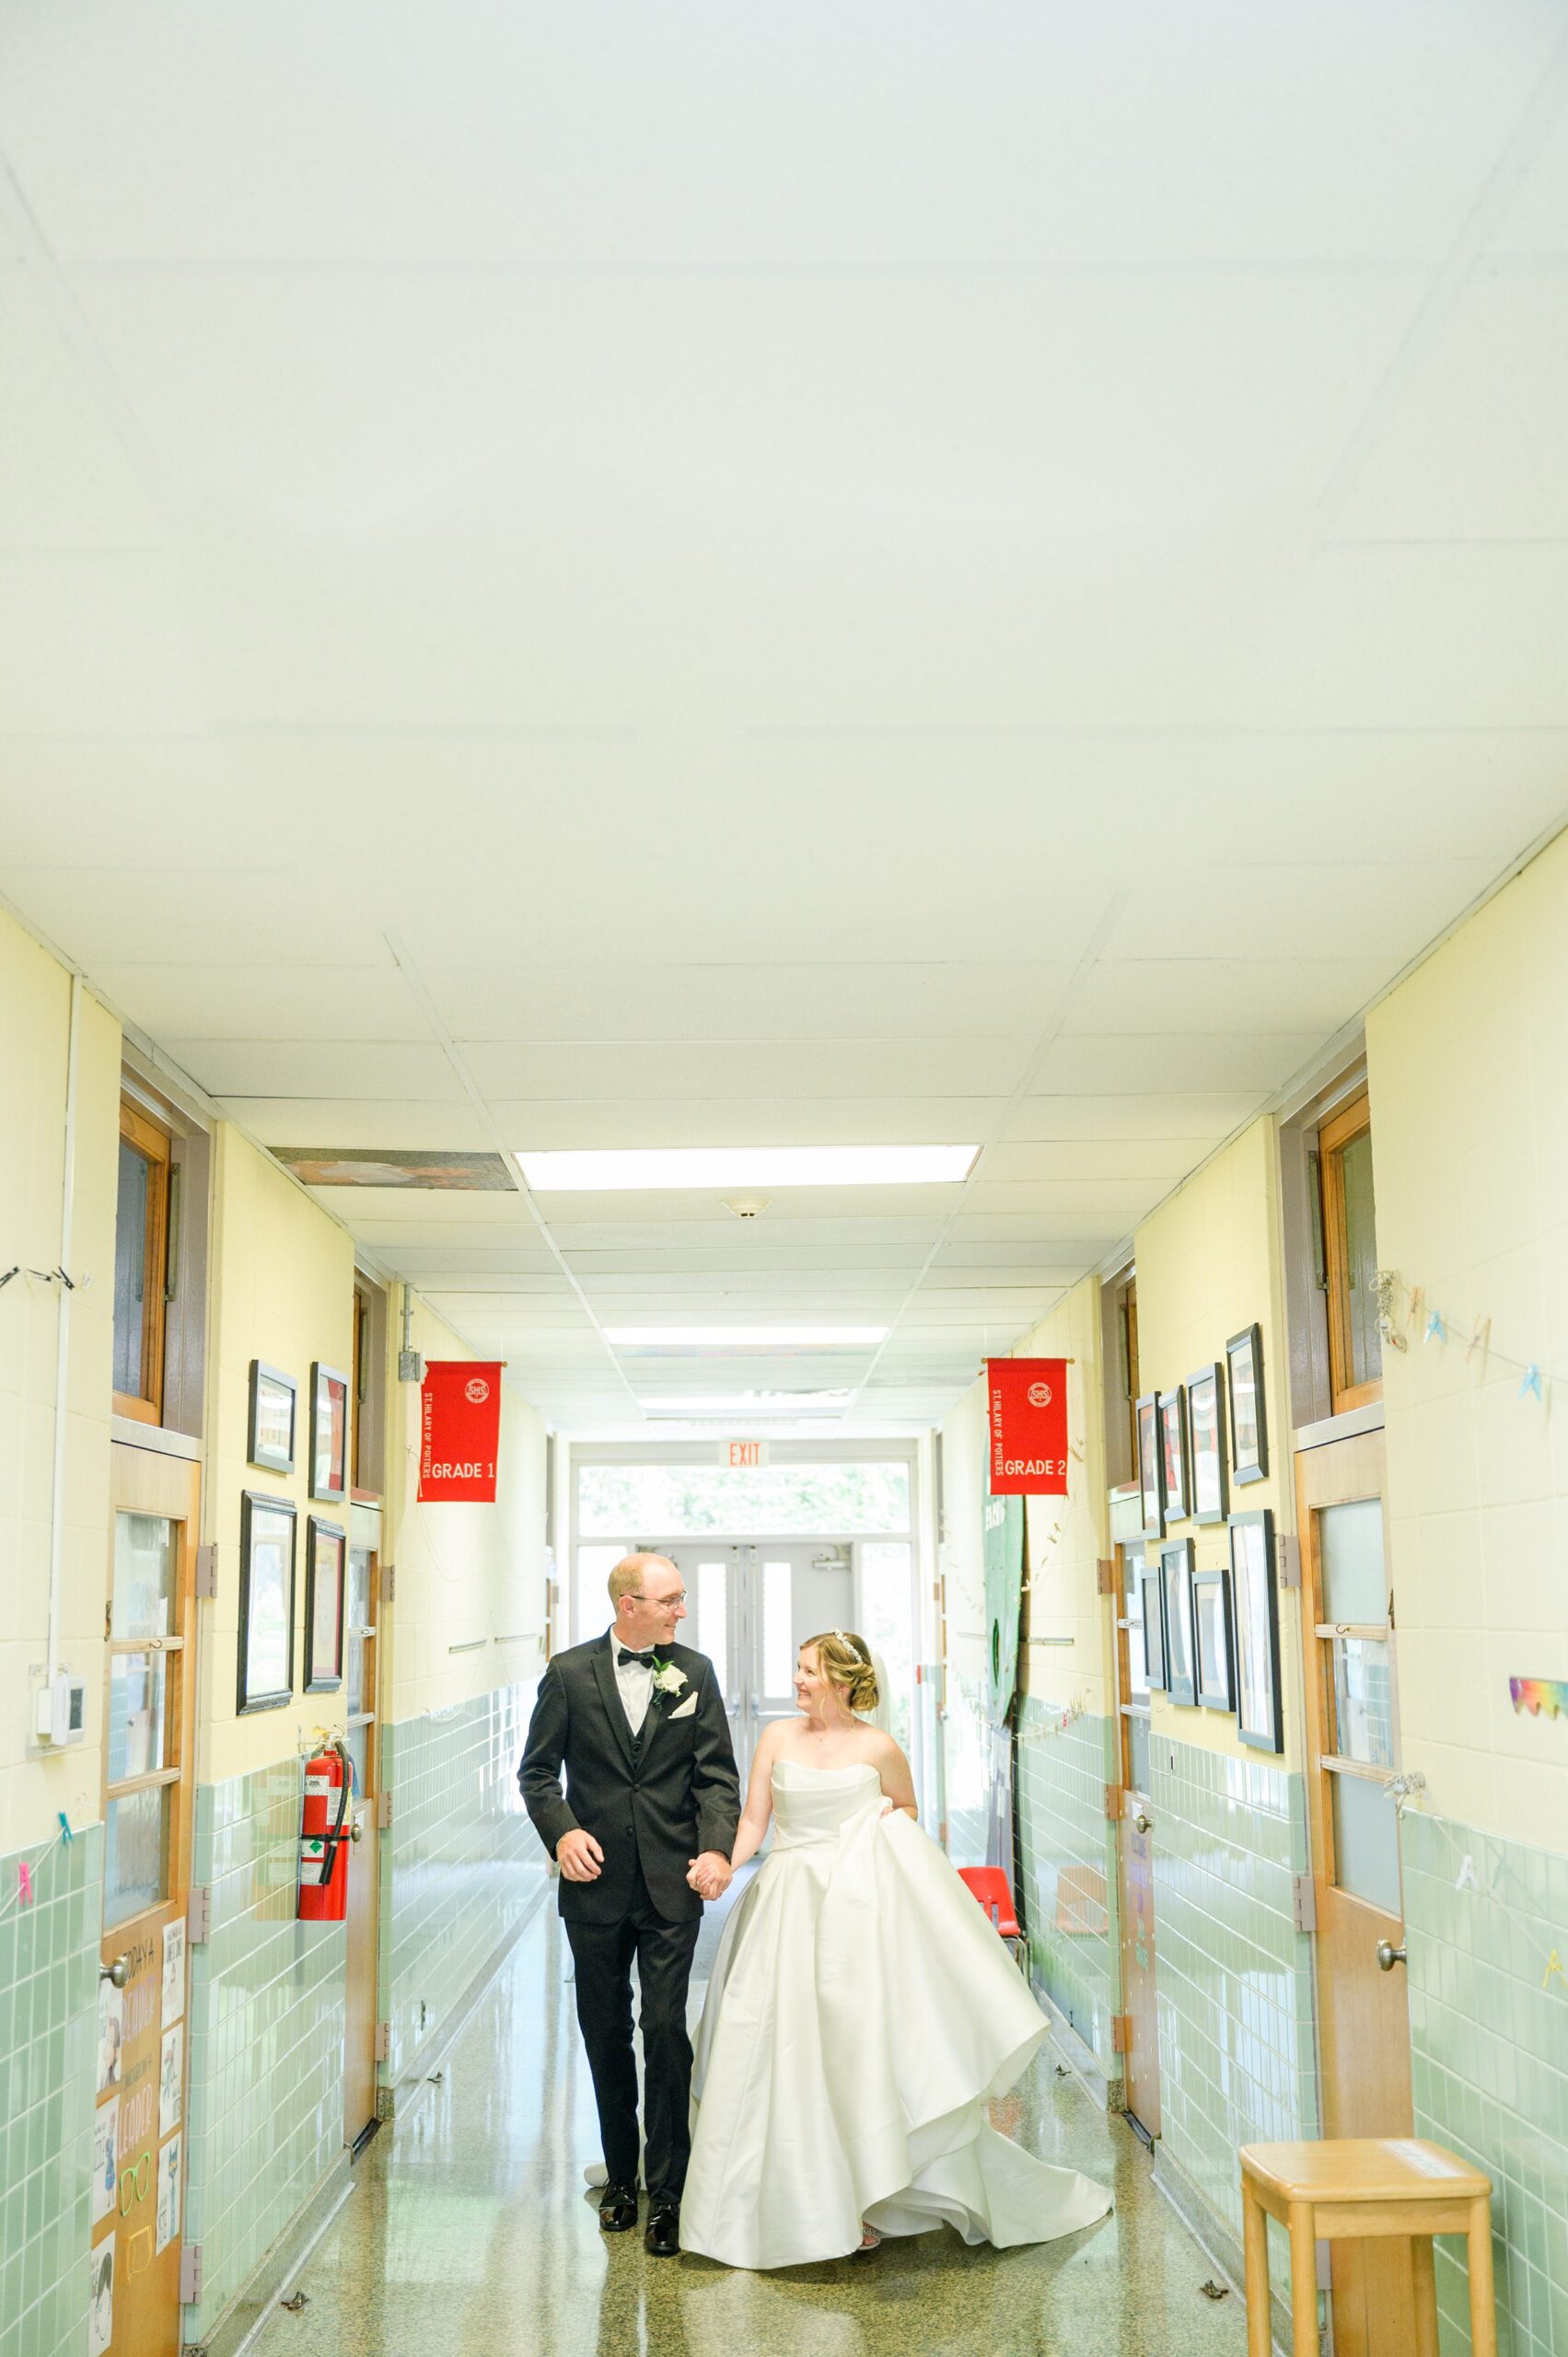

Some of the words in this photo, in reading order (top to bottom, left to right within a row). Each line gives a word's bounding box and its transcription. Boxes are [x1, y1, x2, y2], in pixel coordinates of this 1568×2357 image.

[424, 1404, 433, 1431] HILARY
[993, 1400, 1003, 1427] HILARY
[424, 1433, 432, 1443] OF
[994, 1429, 1003, 1439] OF
[423, 1446, 432, 1479] POITIERS
[730, 1443, 760, 1466] EXIT
[994, 1443, 1004, 1476] POITIERS
[1005, 1459, 1053, 1475] GRADE
[1058, 1459, 1065, 1475] 2
[432, 1463, 482, 1479] GRADE
[488, 1462, 494, 1478] 1
[118, 2084, 152, 2161] LEADER
